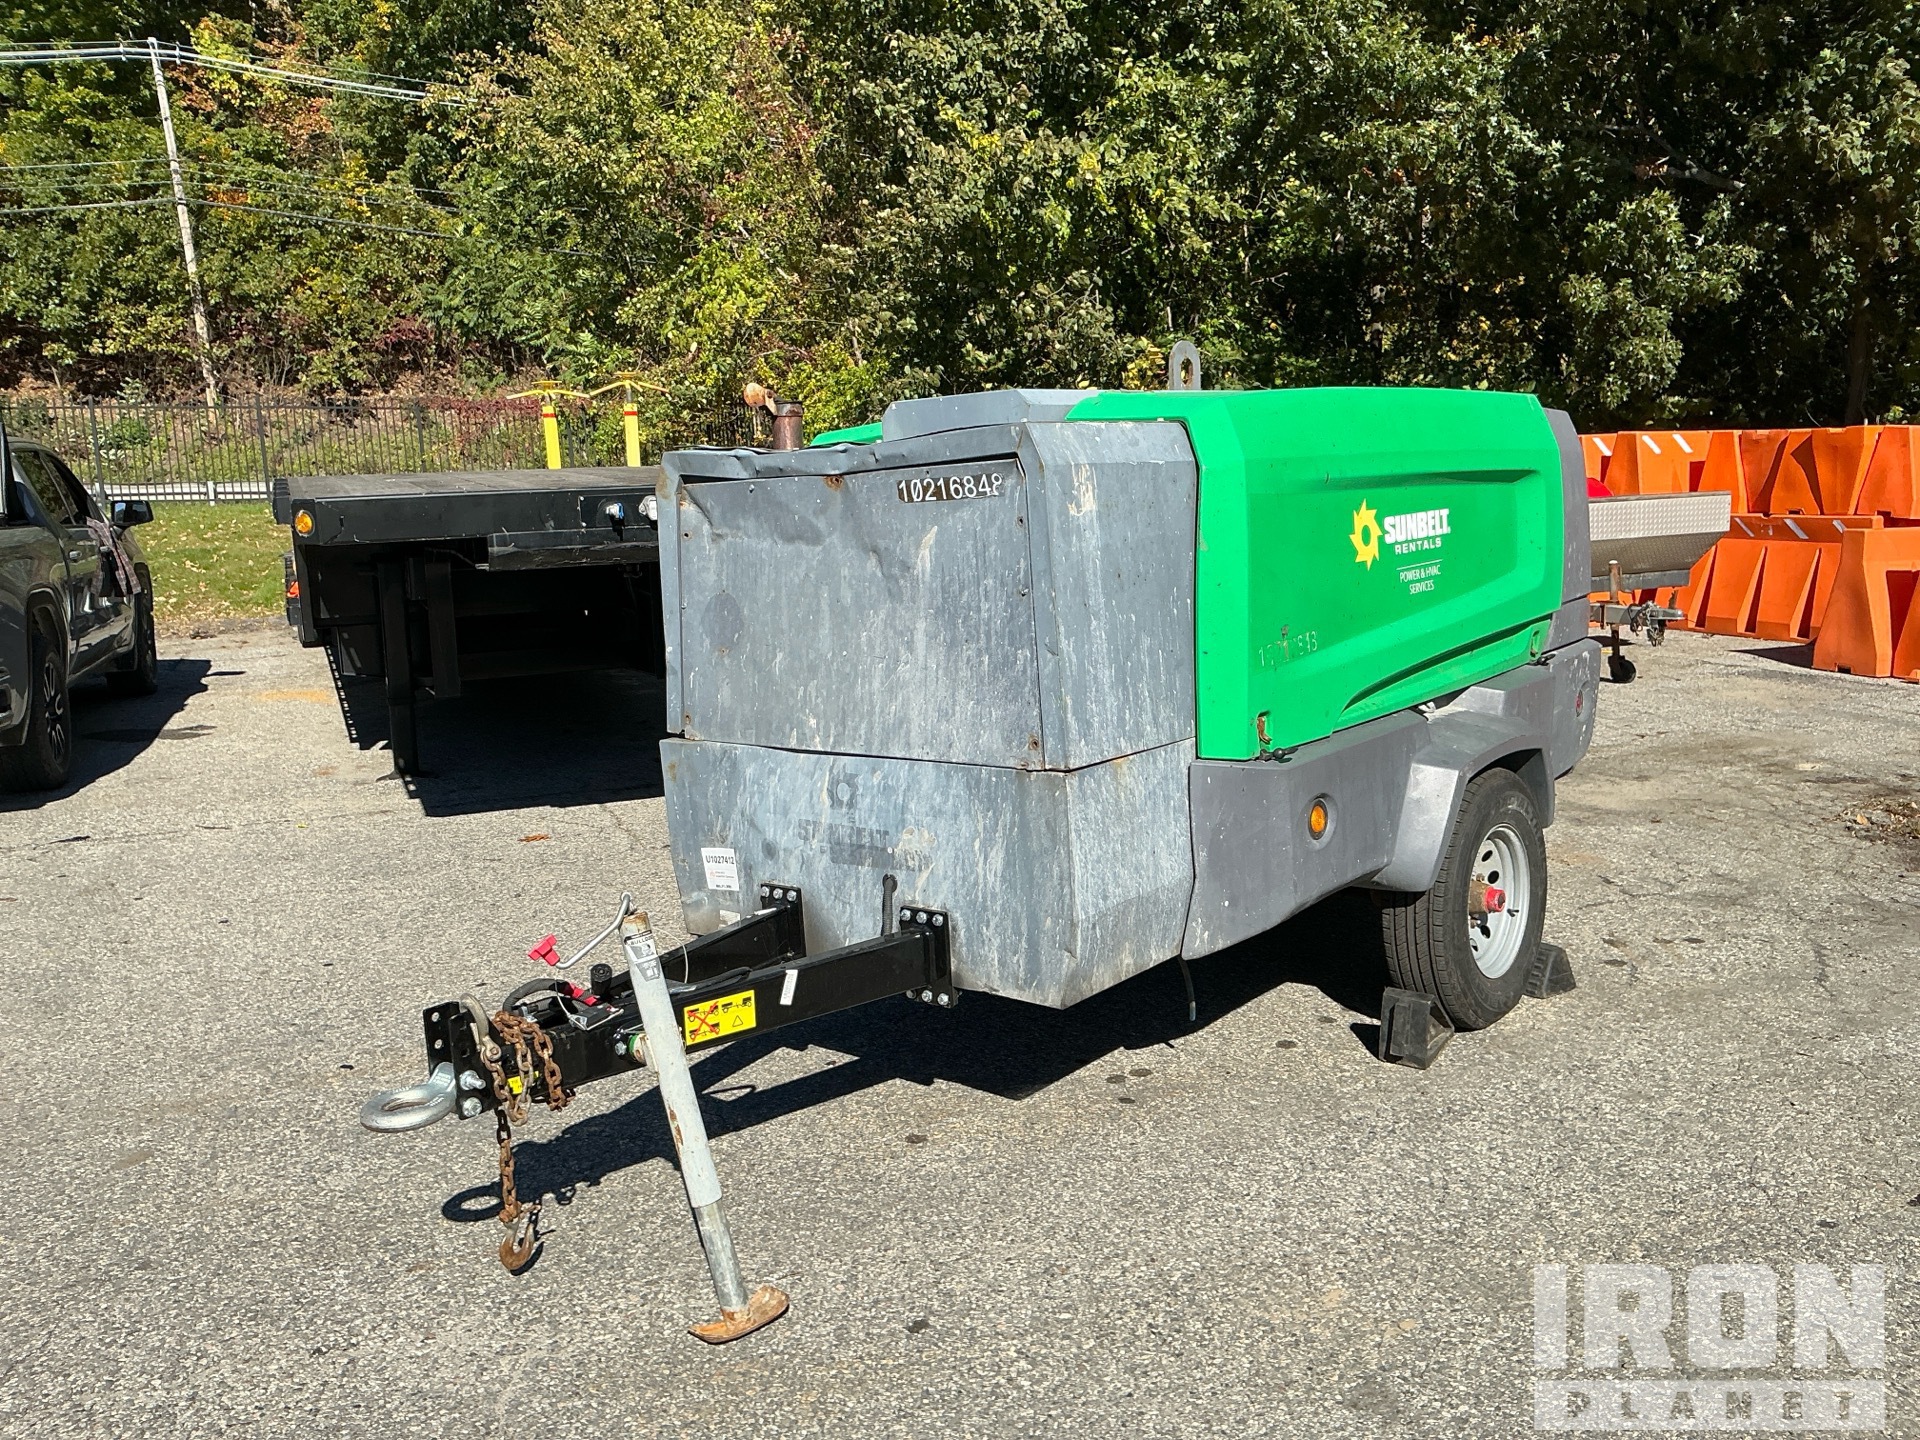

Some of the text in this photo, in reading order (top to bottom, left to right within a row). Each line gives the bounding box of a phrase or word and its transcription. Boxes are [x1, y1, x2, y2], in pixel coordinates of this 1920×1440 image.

[898, 472, 1002, 502] 10216848
[1384, 508, 1450, 544] SUNBELT
[1395, 537, 1442, 555] RENTALS
[1400, 570, 1421, 583] POWER
[1425, 565, 1441, 577] HVAC
[1409, 580, 1435, 594] SERVICES
